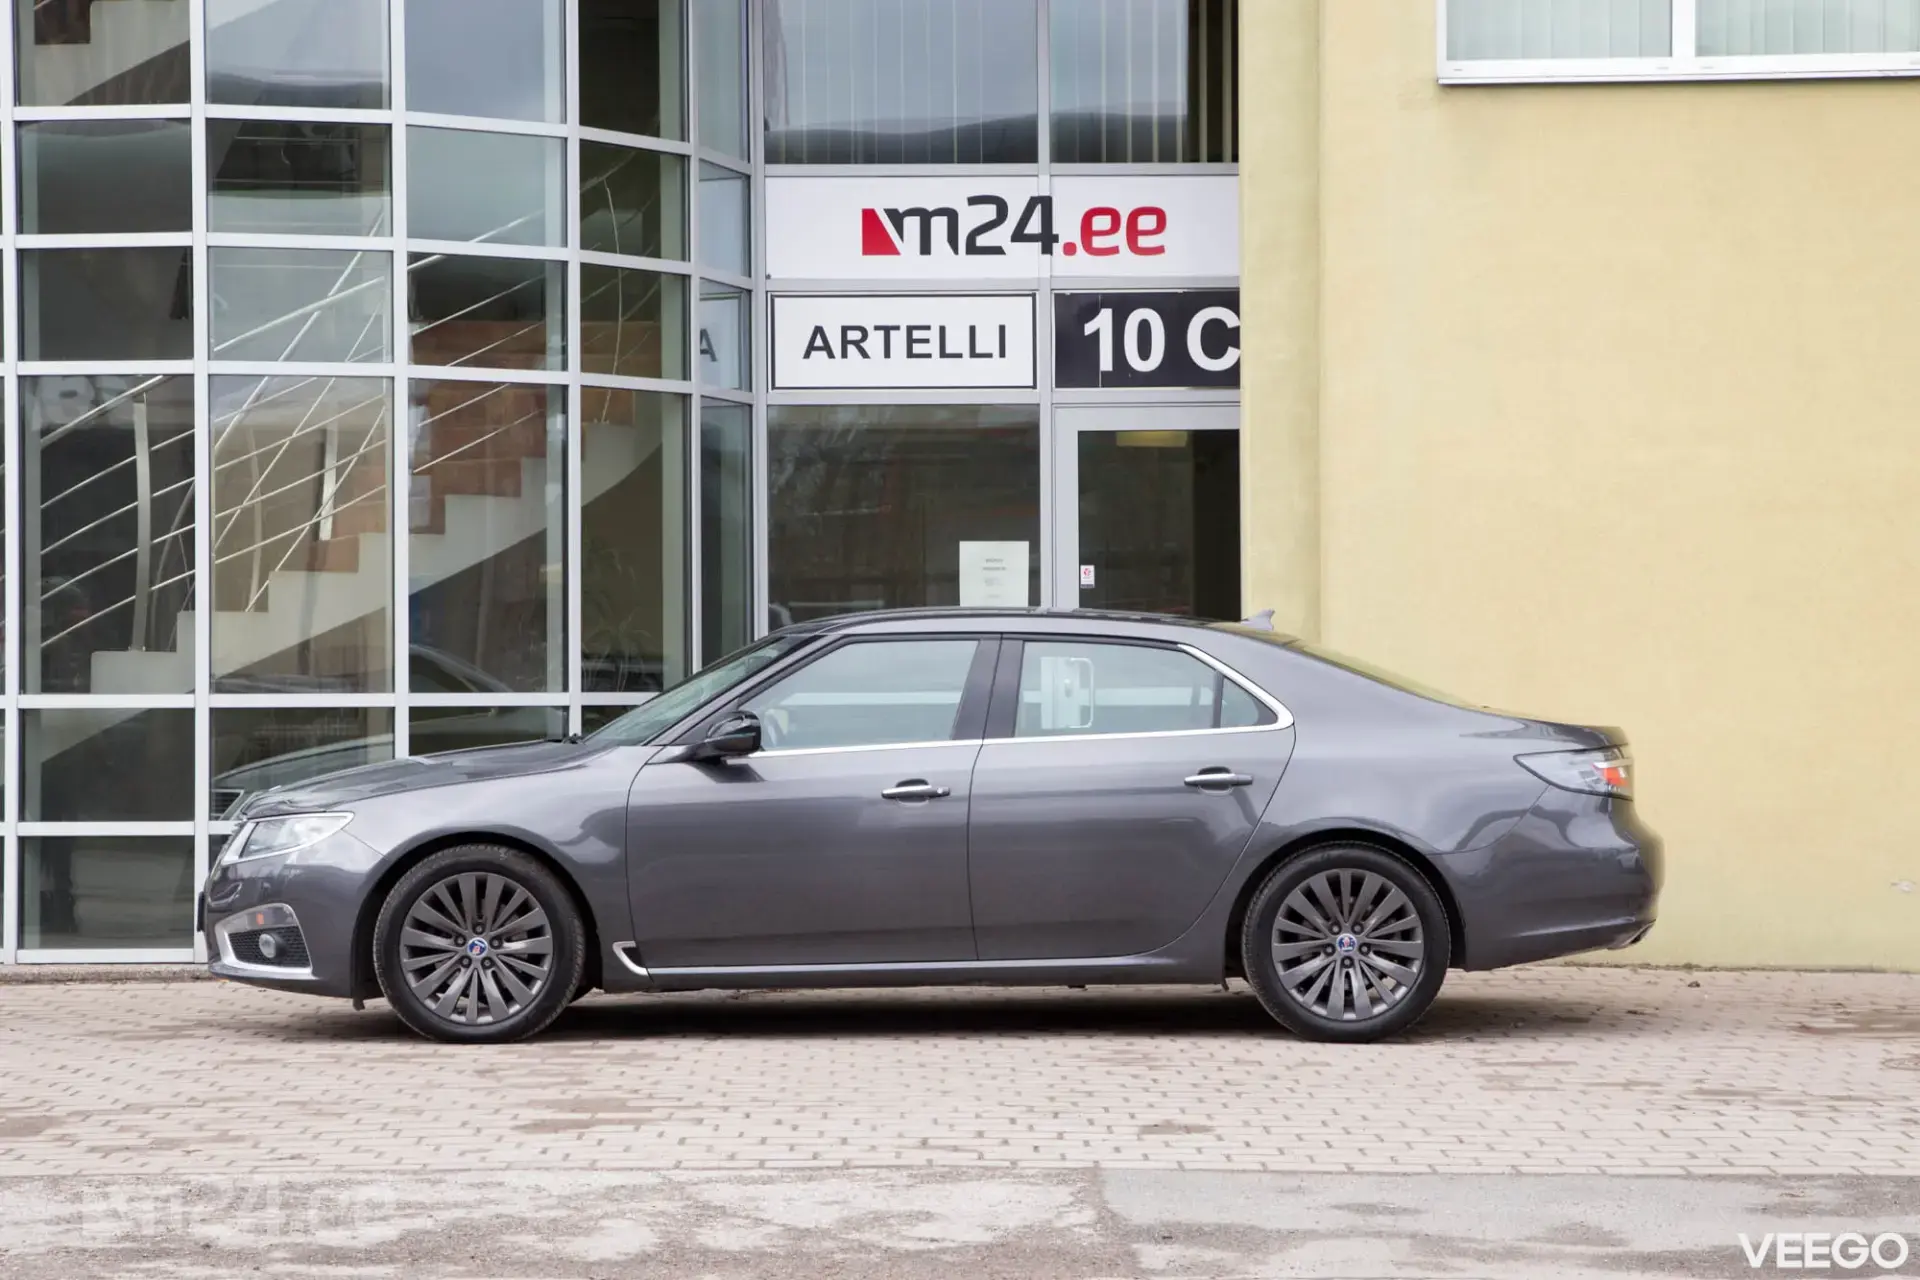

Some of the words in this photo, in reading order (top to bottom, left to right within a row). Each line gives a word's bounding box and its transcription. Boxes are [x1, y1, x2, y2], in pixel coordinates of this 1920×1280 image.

[884, 195, 1167, 256] m24.ee
[803, 325, 1007, 359] ARTELLI
[1083, 308, 1166, 372] 10
